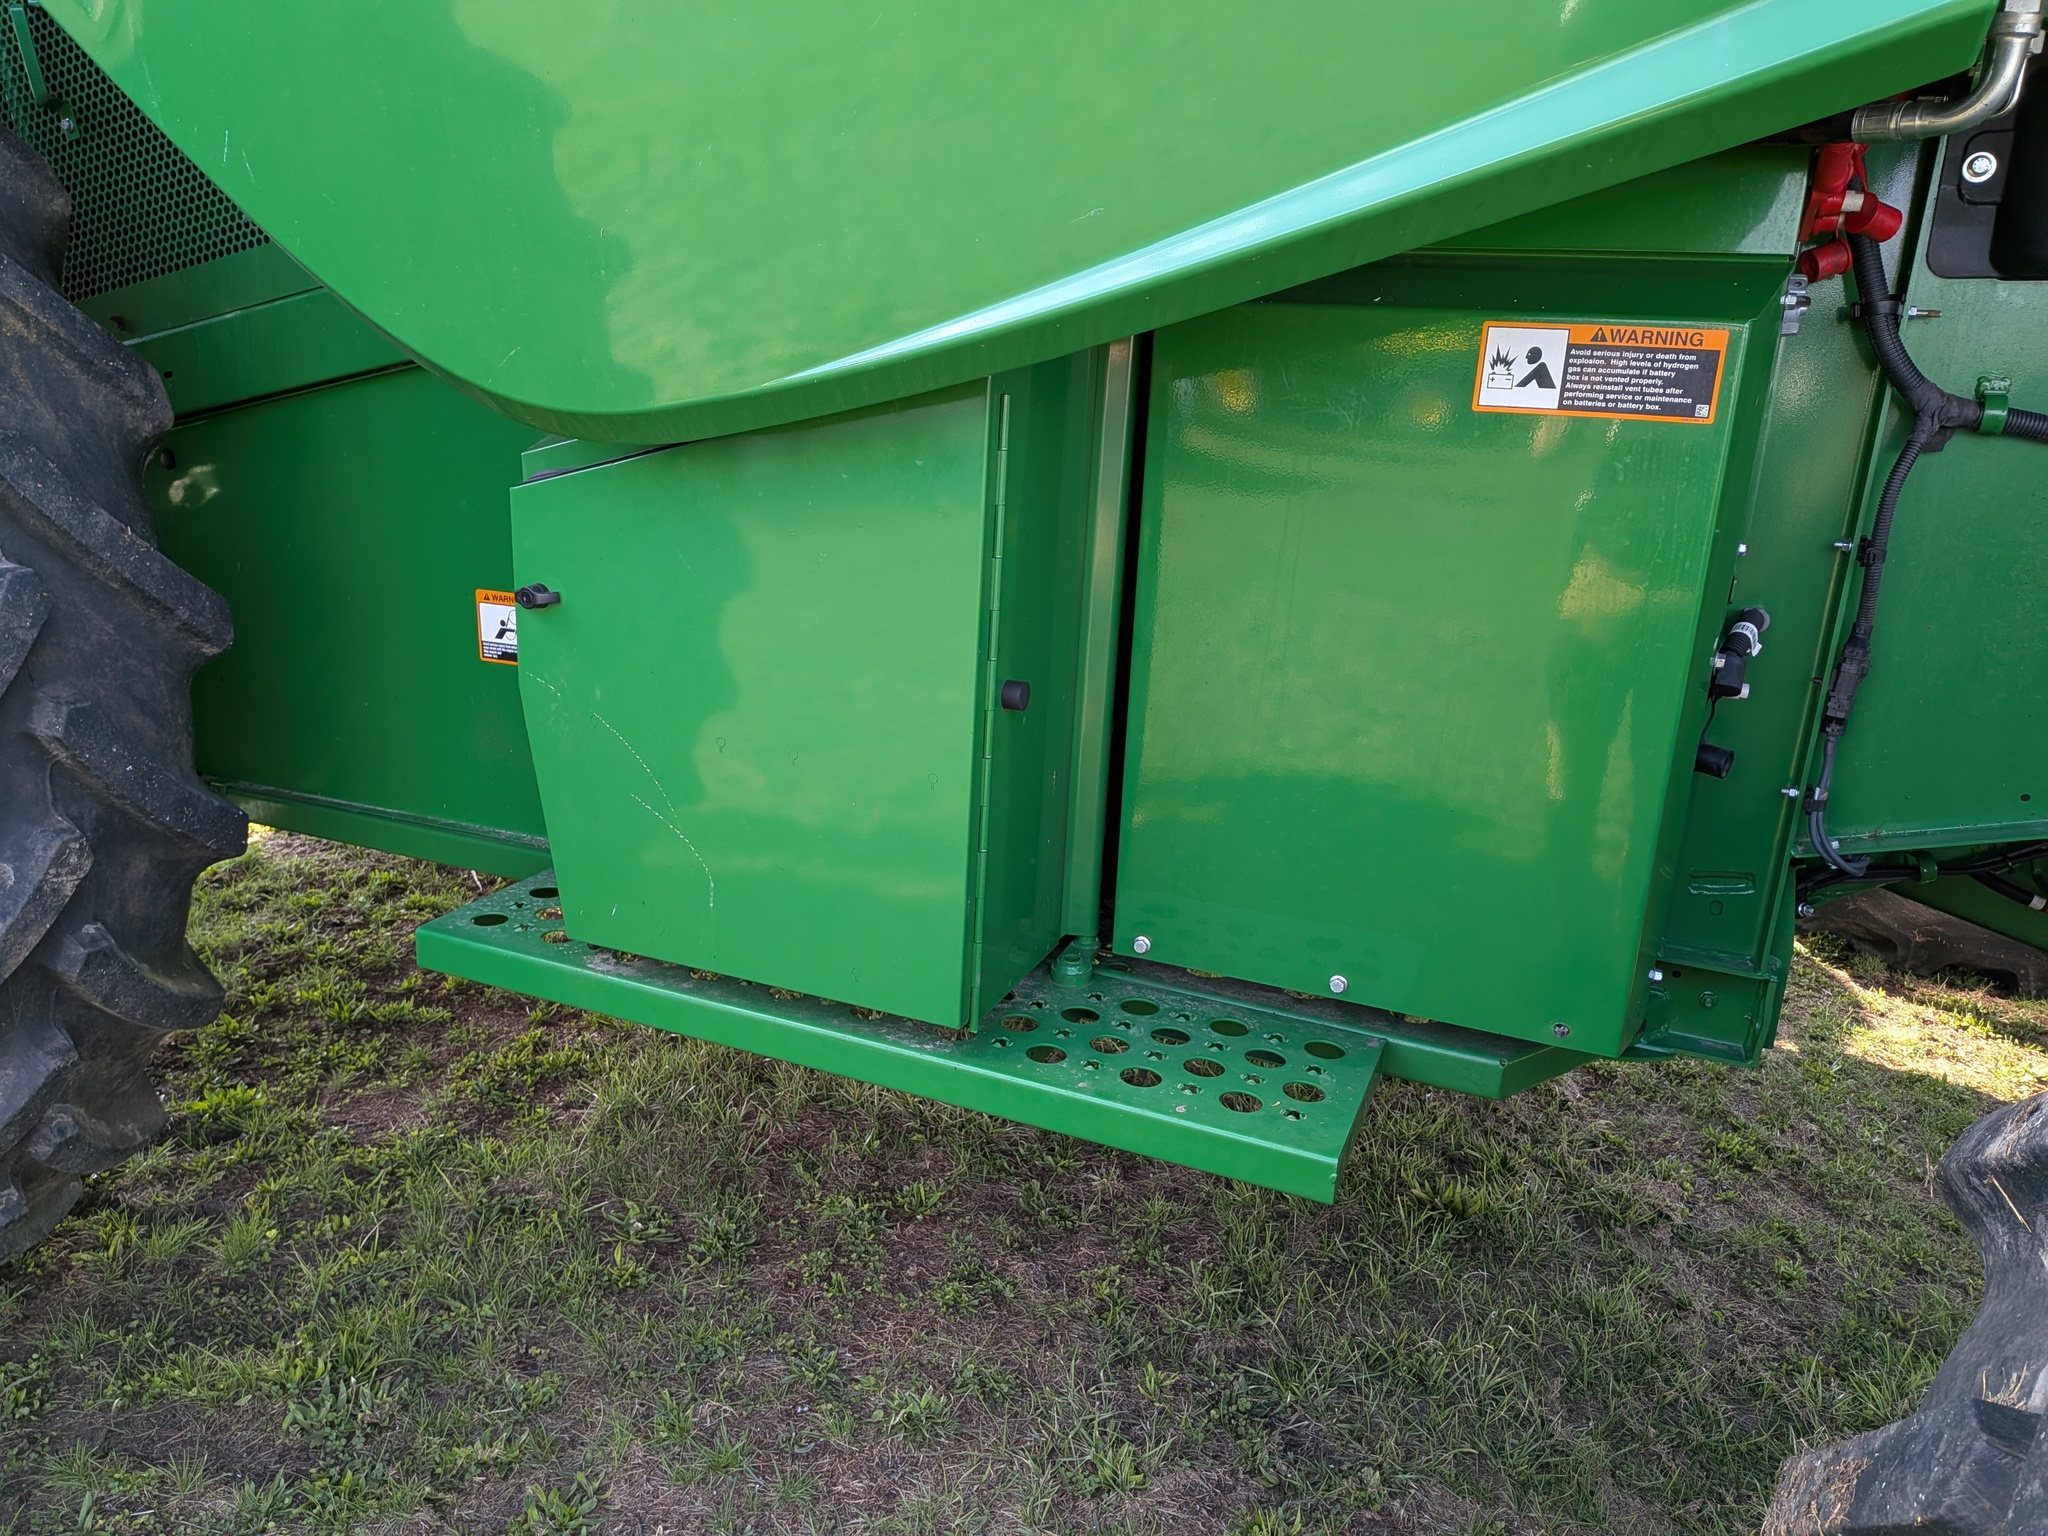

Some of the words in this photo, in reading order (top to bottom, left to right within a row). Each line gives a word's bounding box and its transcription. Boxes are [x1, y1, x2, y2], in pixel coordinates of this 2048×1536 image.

[1610, 328, 1704, 347] WARNING
[1622, 351, 1644, 359] injury
[1663, 362, 1698, 370] hydrogen
[1649, 370, 1676, 378] battery
[1564, 391, 1604, 400] performing
[1644, 395, 1692, 403] maintenance
